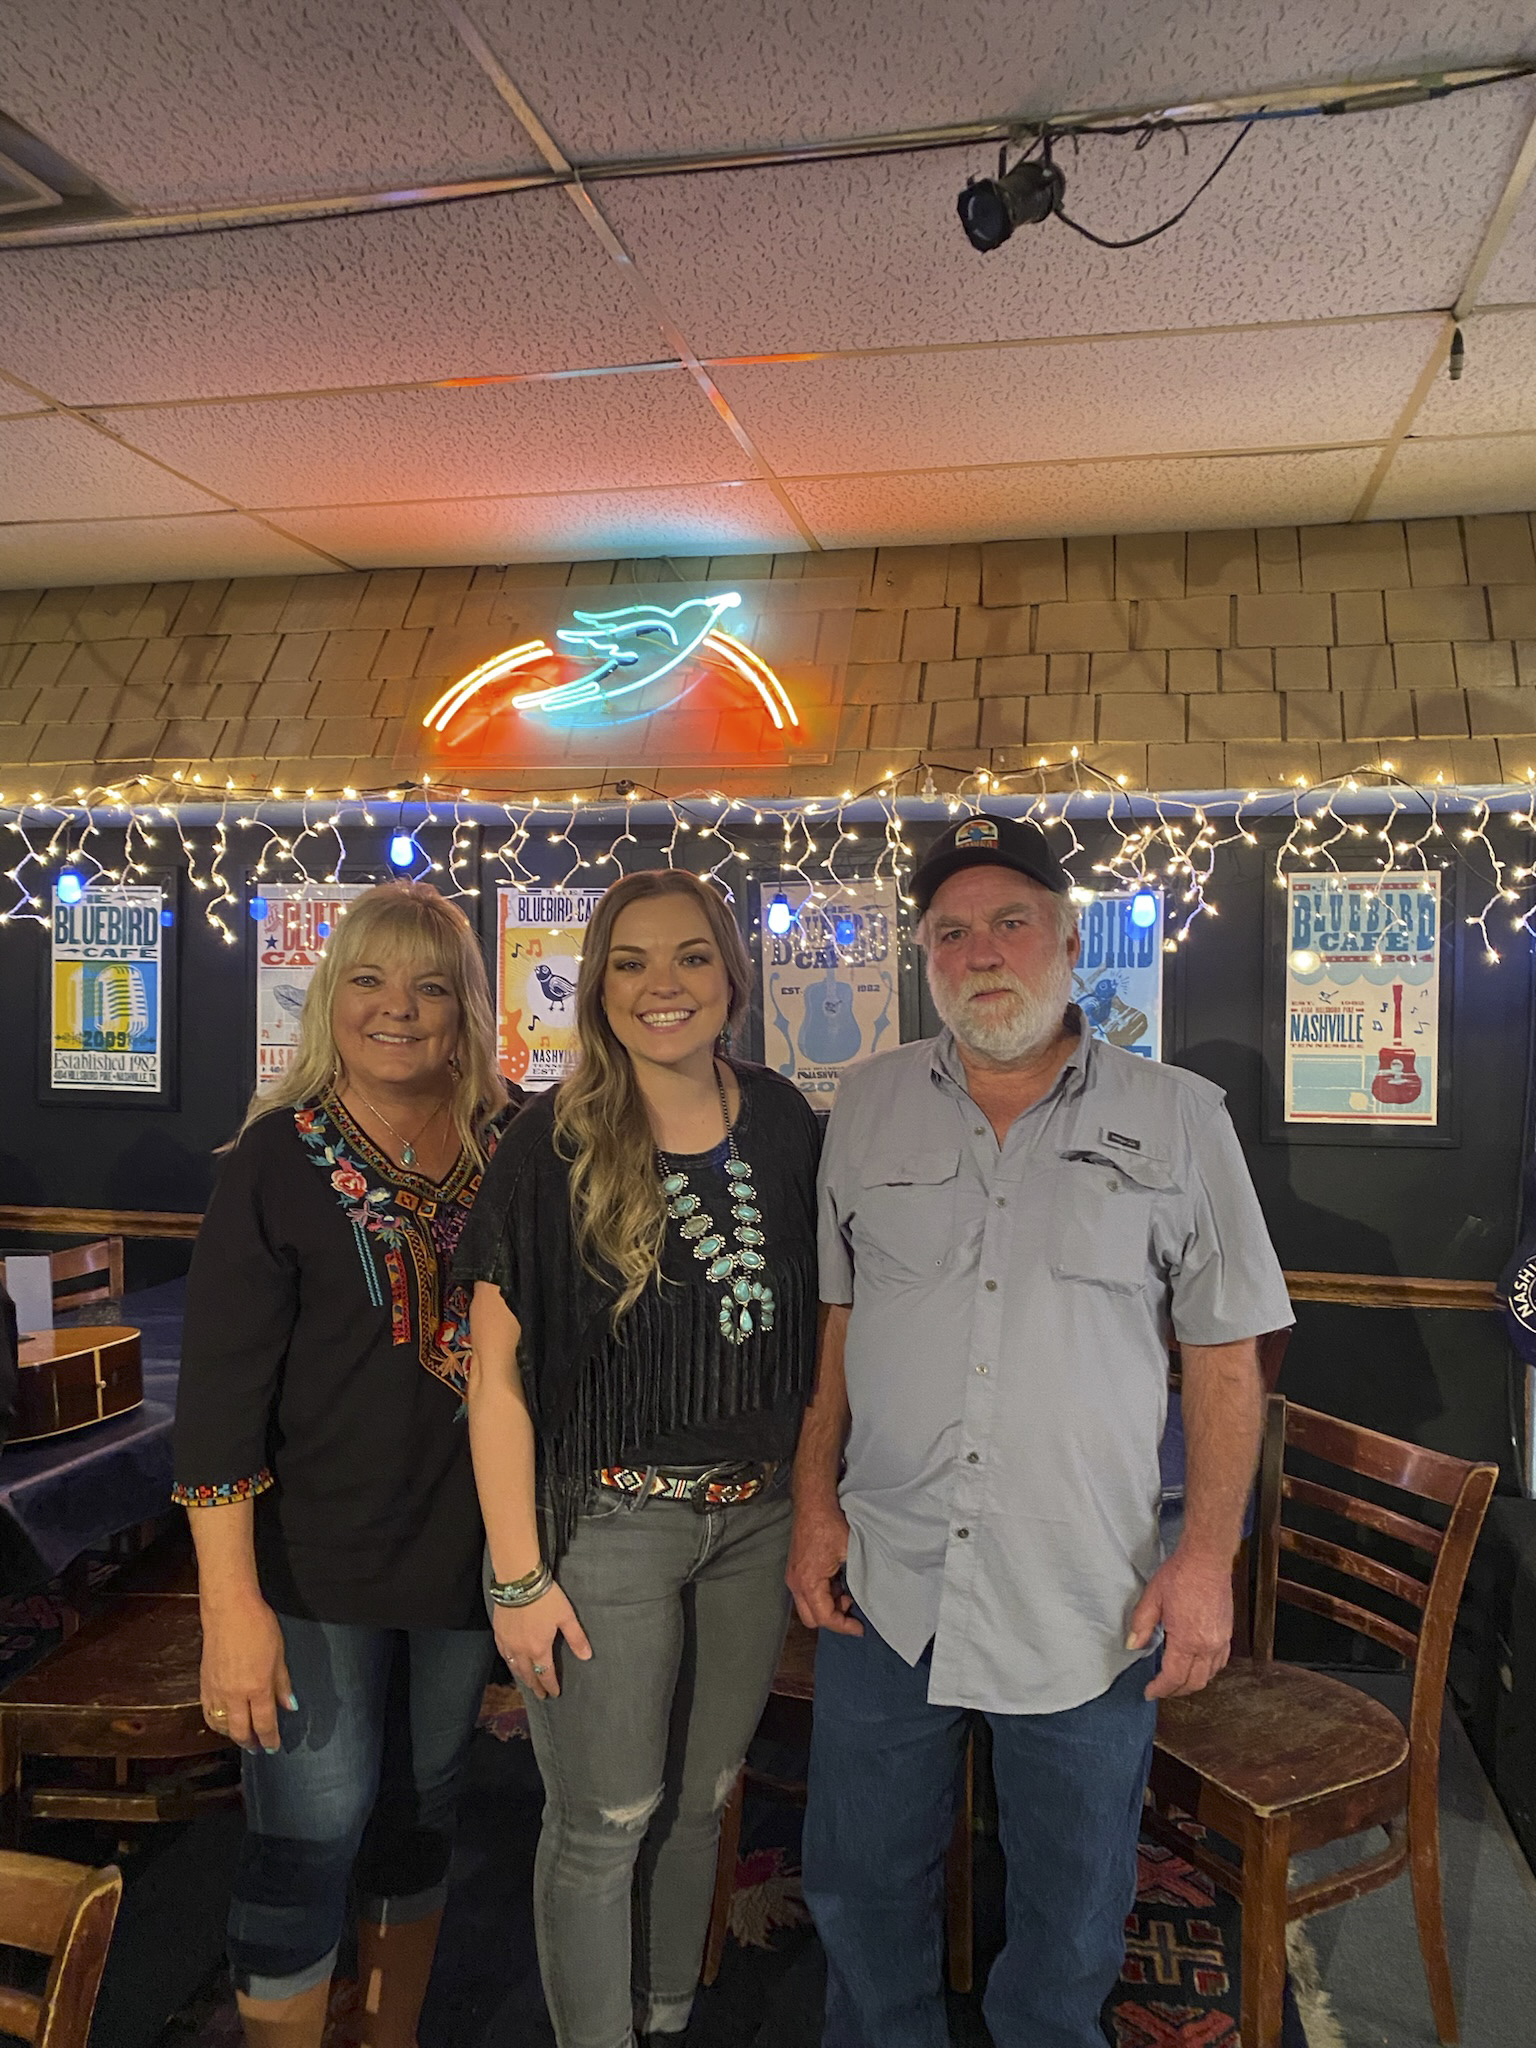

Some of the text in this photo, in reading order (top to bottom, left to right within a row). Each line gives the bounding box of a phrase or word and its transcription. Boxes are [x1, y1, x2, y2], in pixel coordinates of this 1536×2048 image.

[518, 897, 600, 922] BLUEBIRD CAF
[54, 905, 159, 945] BLUEBIRD
[1293, 894, 1436, 951] BLUEBIRD
[1319, 932, 1409, 951] CAFE
[82, 1030, 128, 1048] 2009
[1290, 1014, 1364, 1042] NASHVILLE
[54, 1053, 157, 1072] Established 1982
